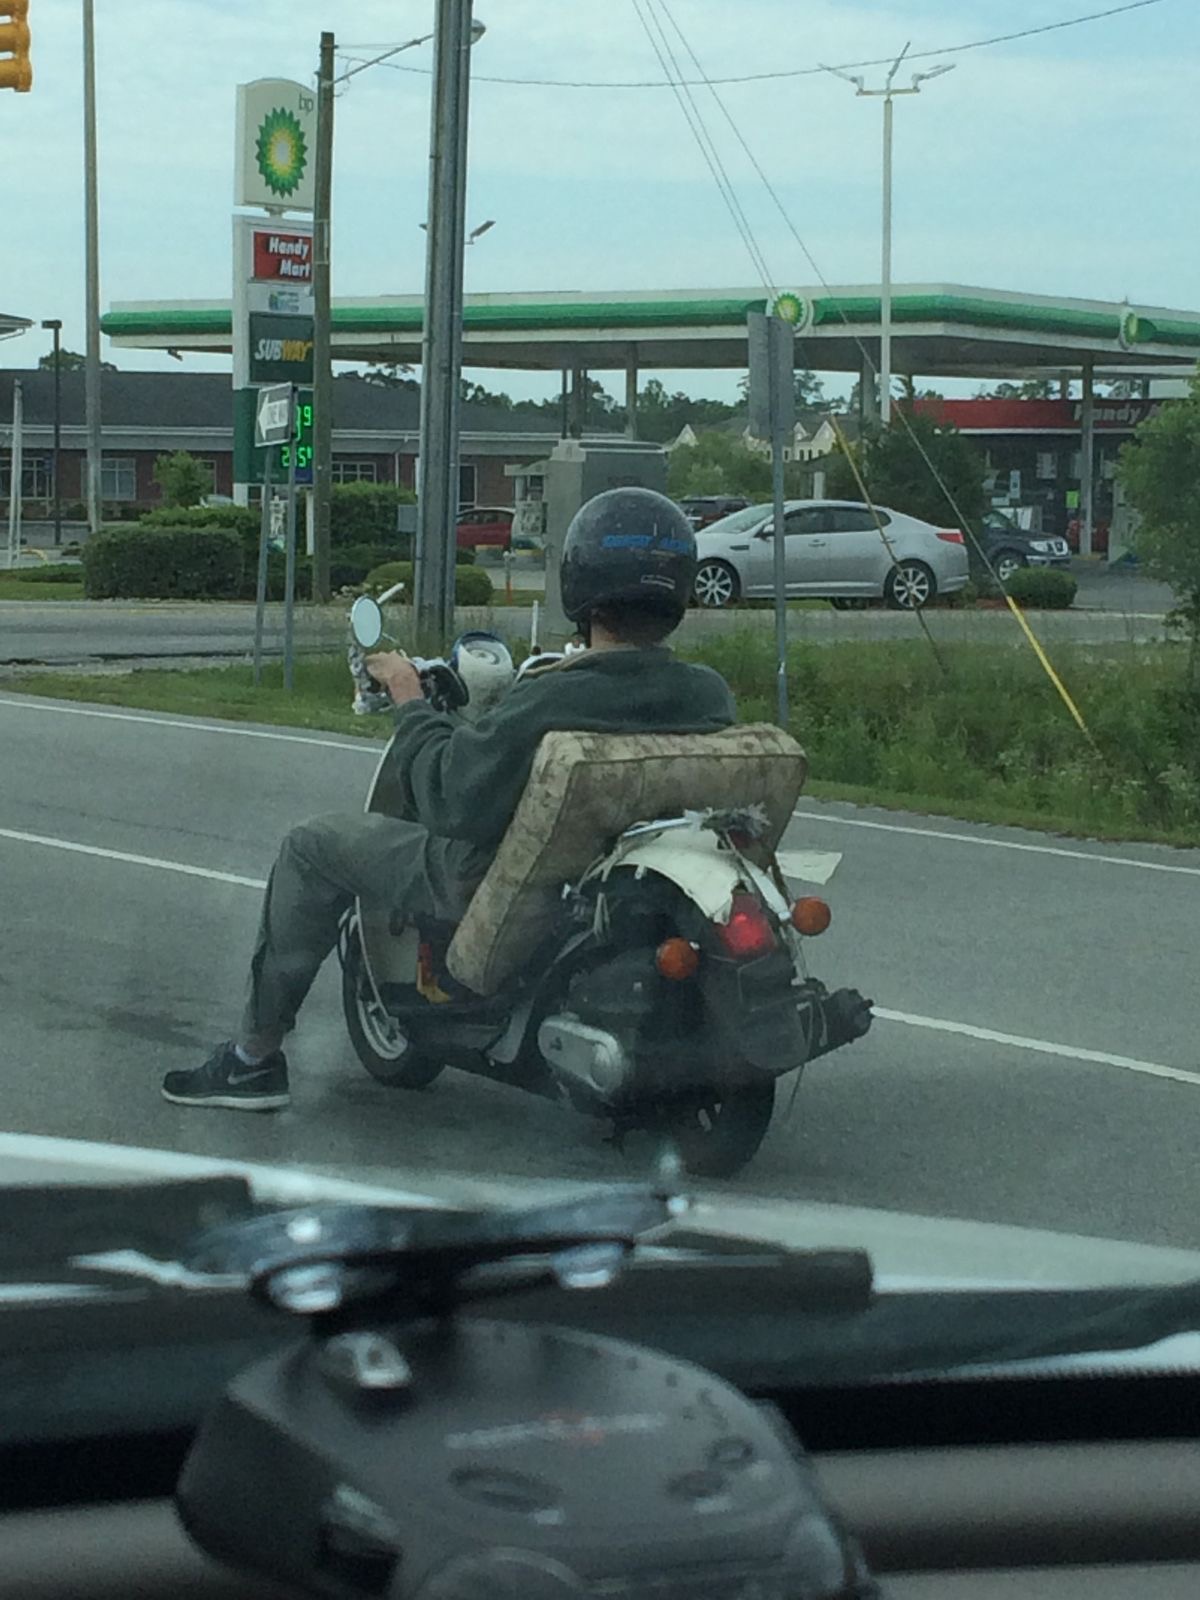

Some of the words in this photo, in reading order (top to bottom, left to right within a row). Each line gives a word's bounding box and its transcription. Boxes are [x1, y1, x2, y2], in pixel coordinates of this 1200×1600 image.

[299, 92, 314, 115] bp
[269, 236, 309, 260] Handy
[280, 259, 310, 278] Mart
[254, 339, 313, 361] SUBWAY
